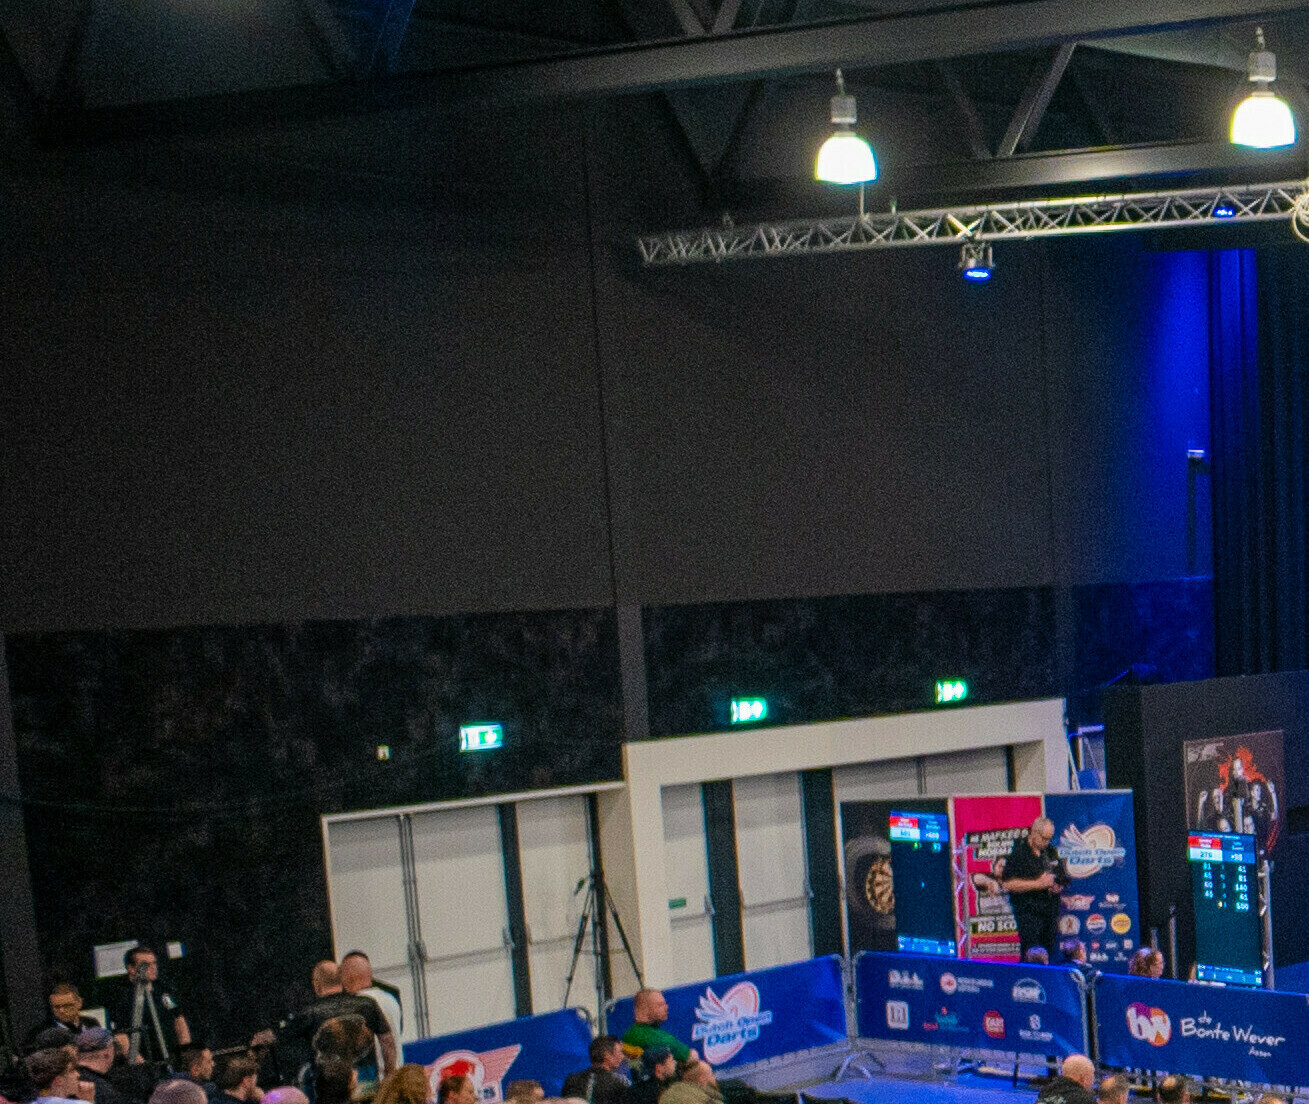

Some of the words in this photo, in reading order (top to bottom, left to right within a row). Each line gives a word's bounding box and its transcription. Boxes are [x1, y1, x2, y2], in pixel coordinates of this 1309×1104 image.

[1198, 1010, 1212, 1024] de
[1180, 1017, 1231, 1041] Bonte
[1232, 1025, 1286, 1047] Wever
